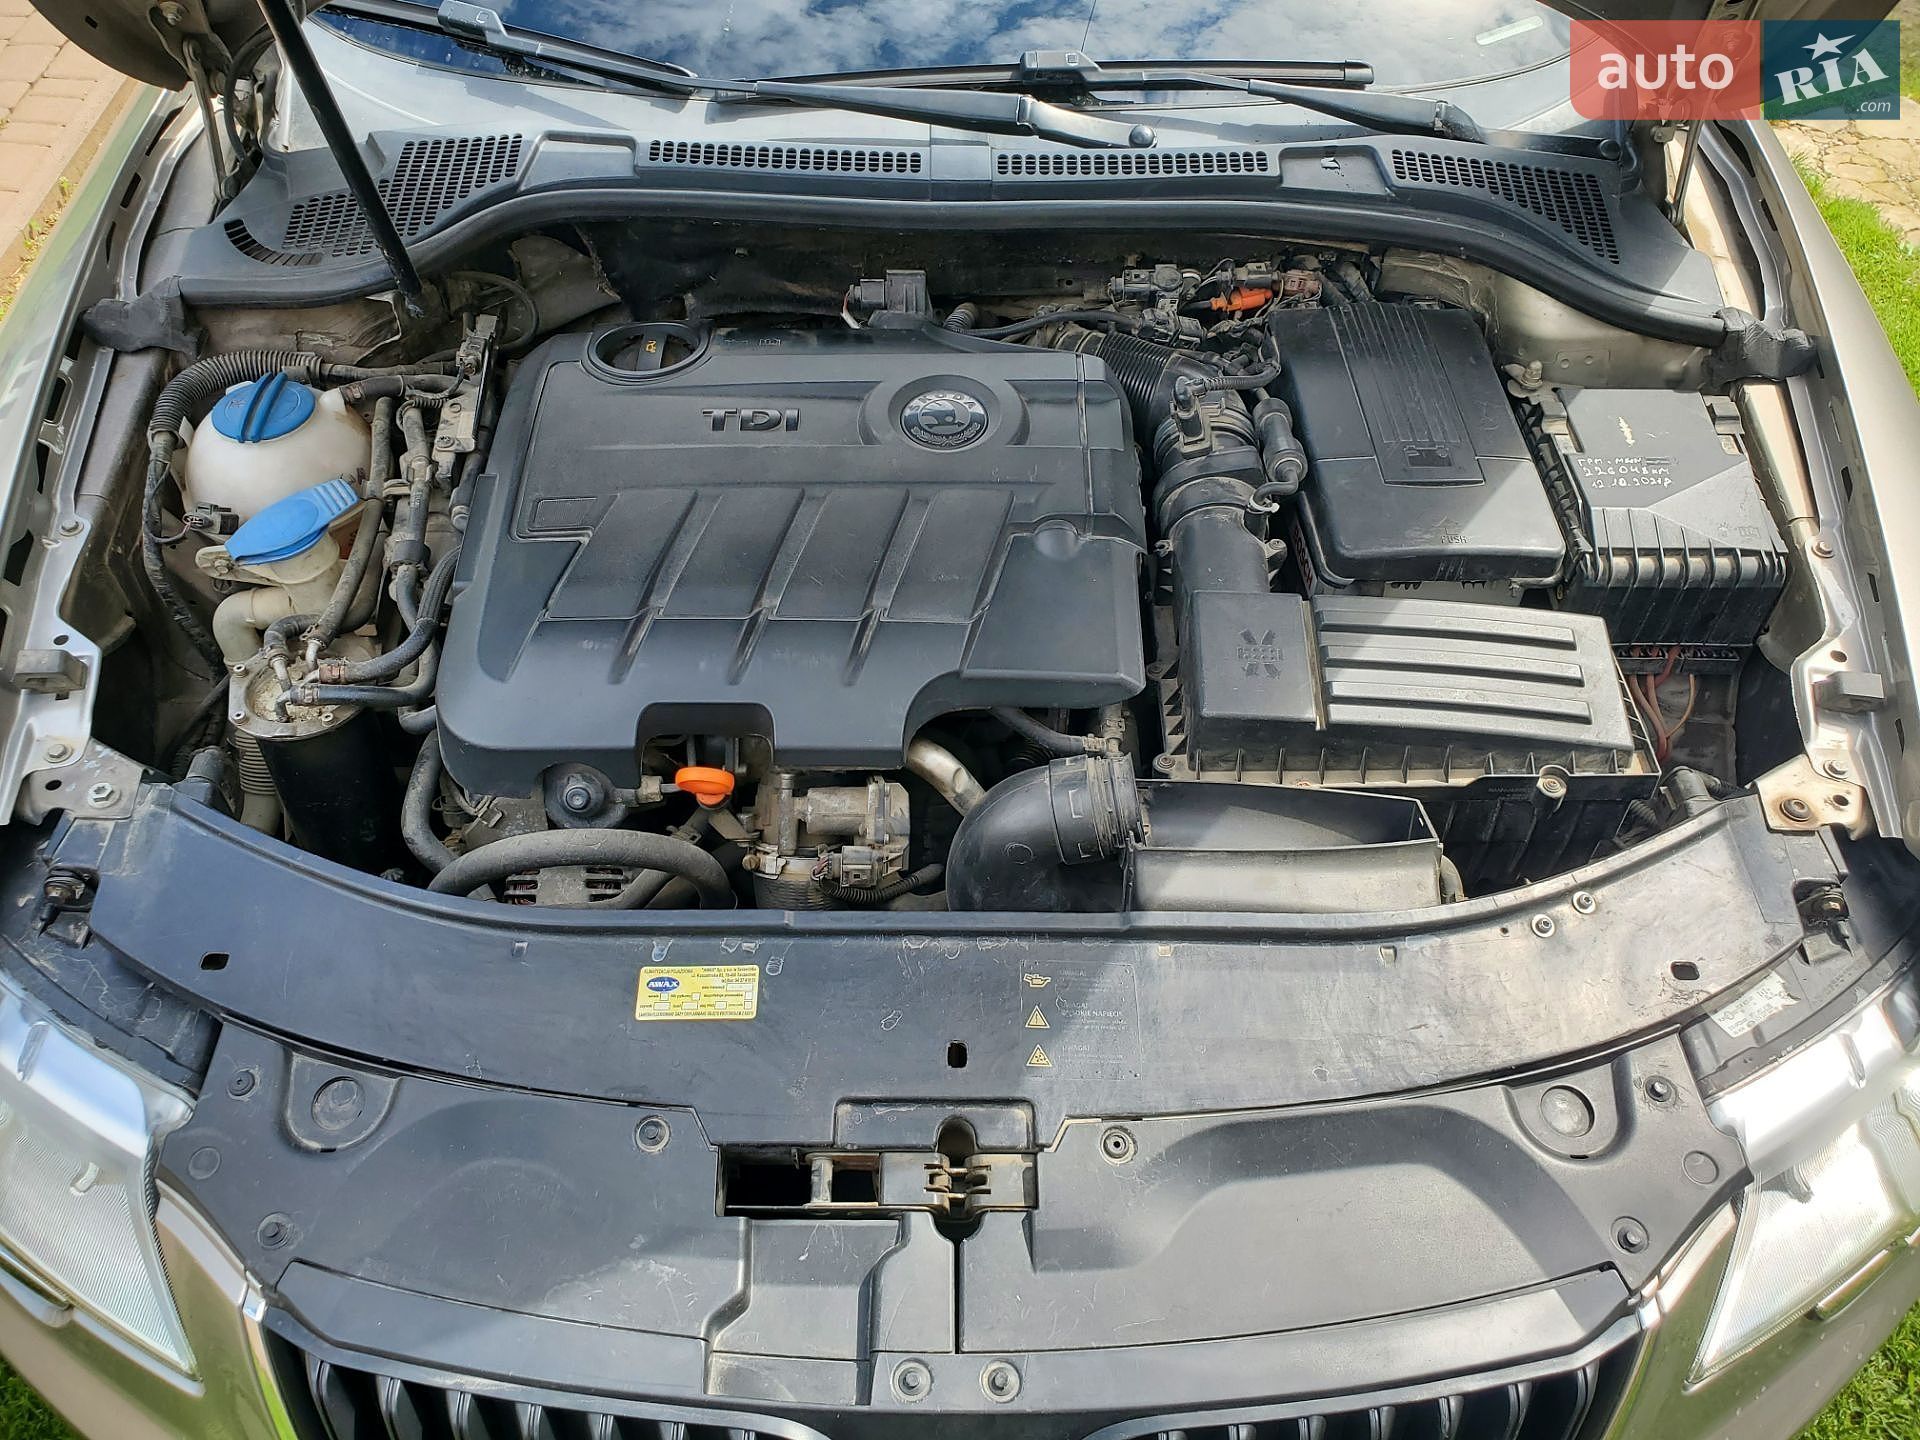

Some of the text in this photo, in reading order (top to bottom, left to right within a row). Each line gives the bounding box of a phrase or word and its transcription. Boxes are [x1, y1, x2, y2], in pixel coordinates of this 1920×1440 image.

[702, 407, 800, 432] TDI
[1440, 534, 1468, 545] PUSH
[648, 980, 679, 988] AWAX
